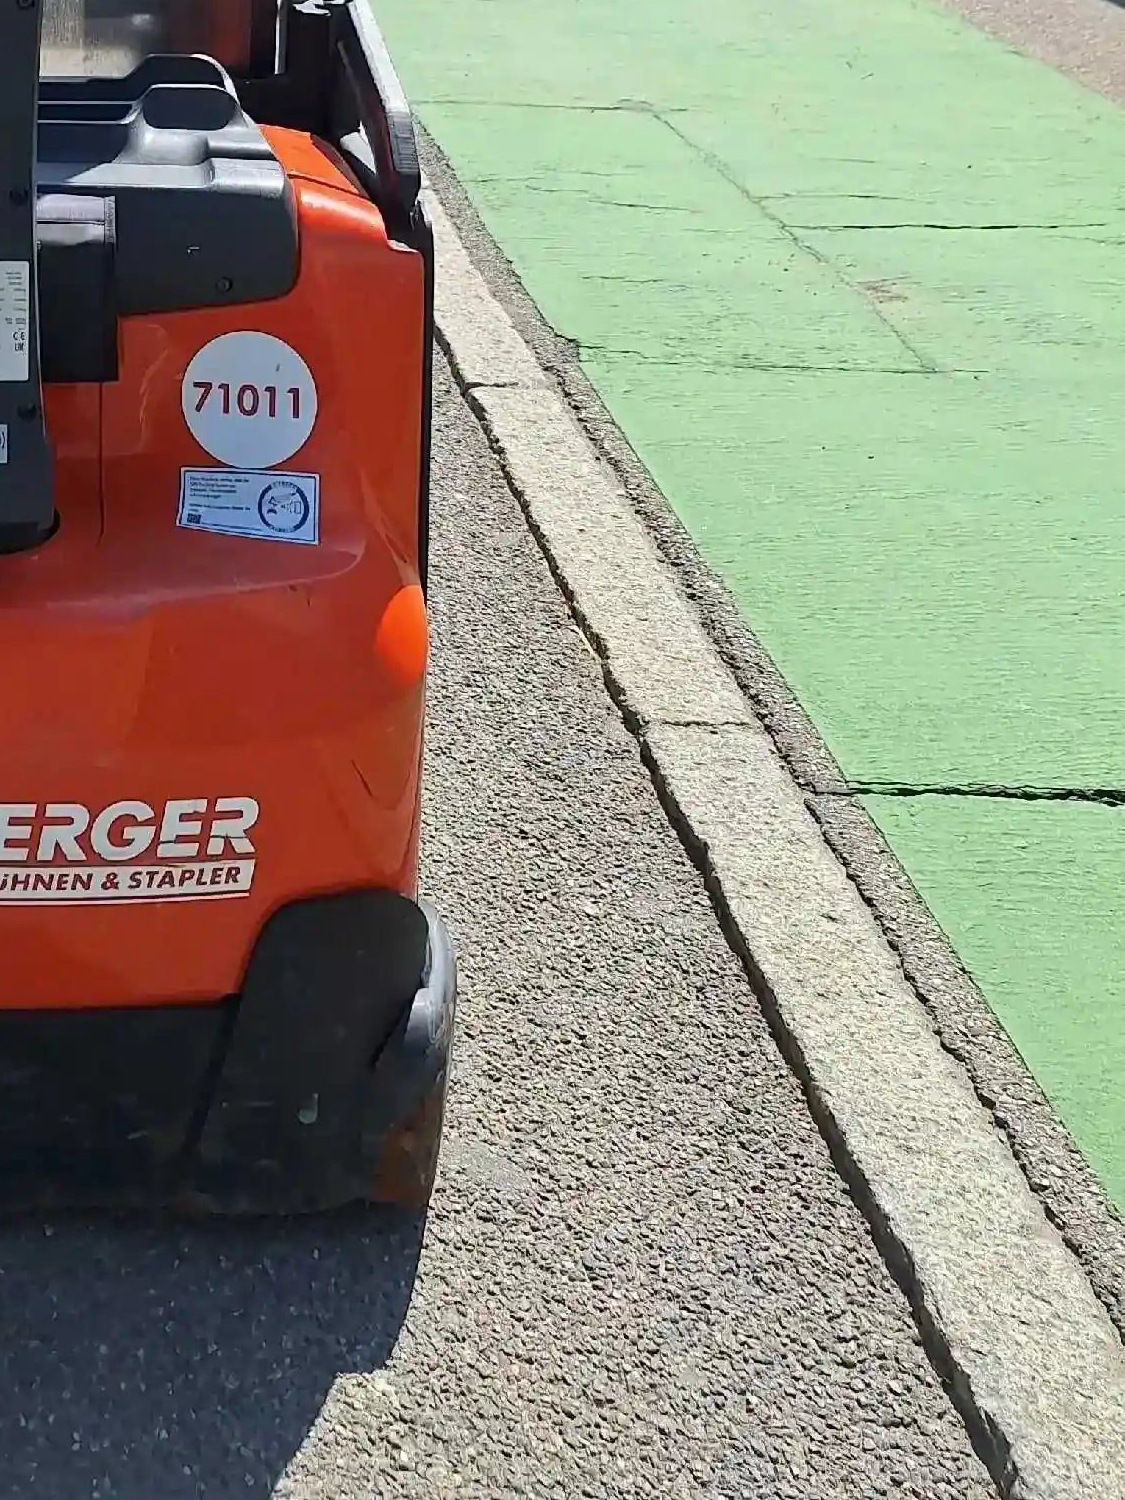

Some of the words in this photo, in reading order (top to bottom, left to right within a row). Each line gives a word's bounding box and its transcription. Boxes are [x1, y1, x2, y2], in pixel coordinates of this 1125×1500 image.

[192, 380, 301, 419] 71011
[100, 869, 121, 890] &
[127, 865, 241, 889] STAPLER
